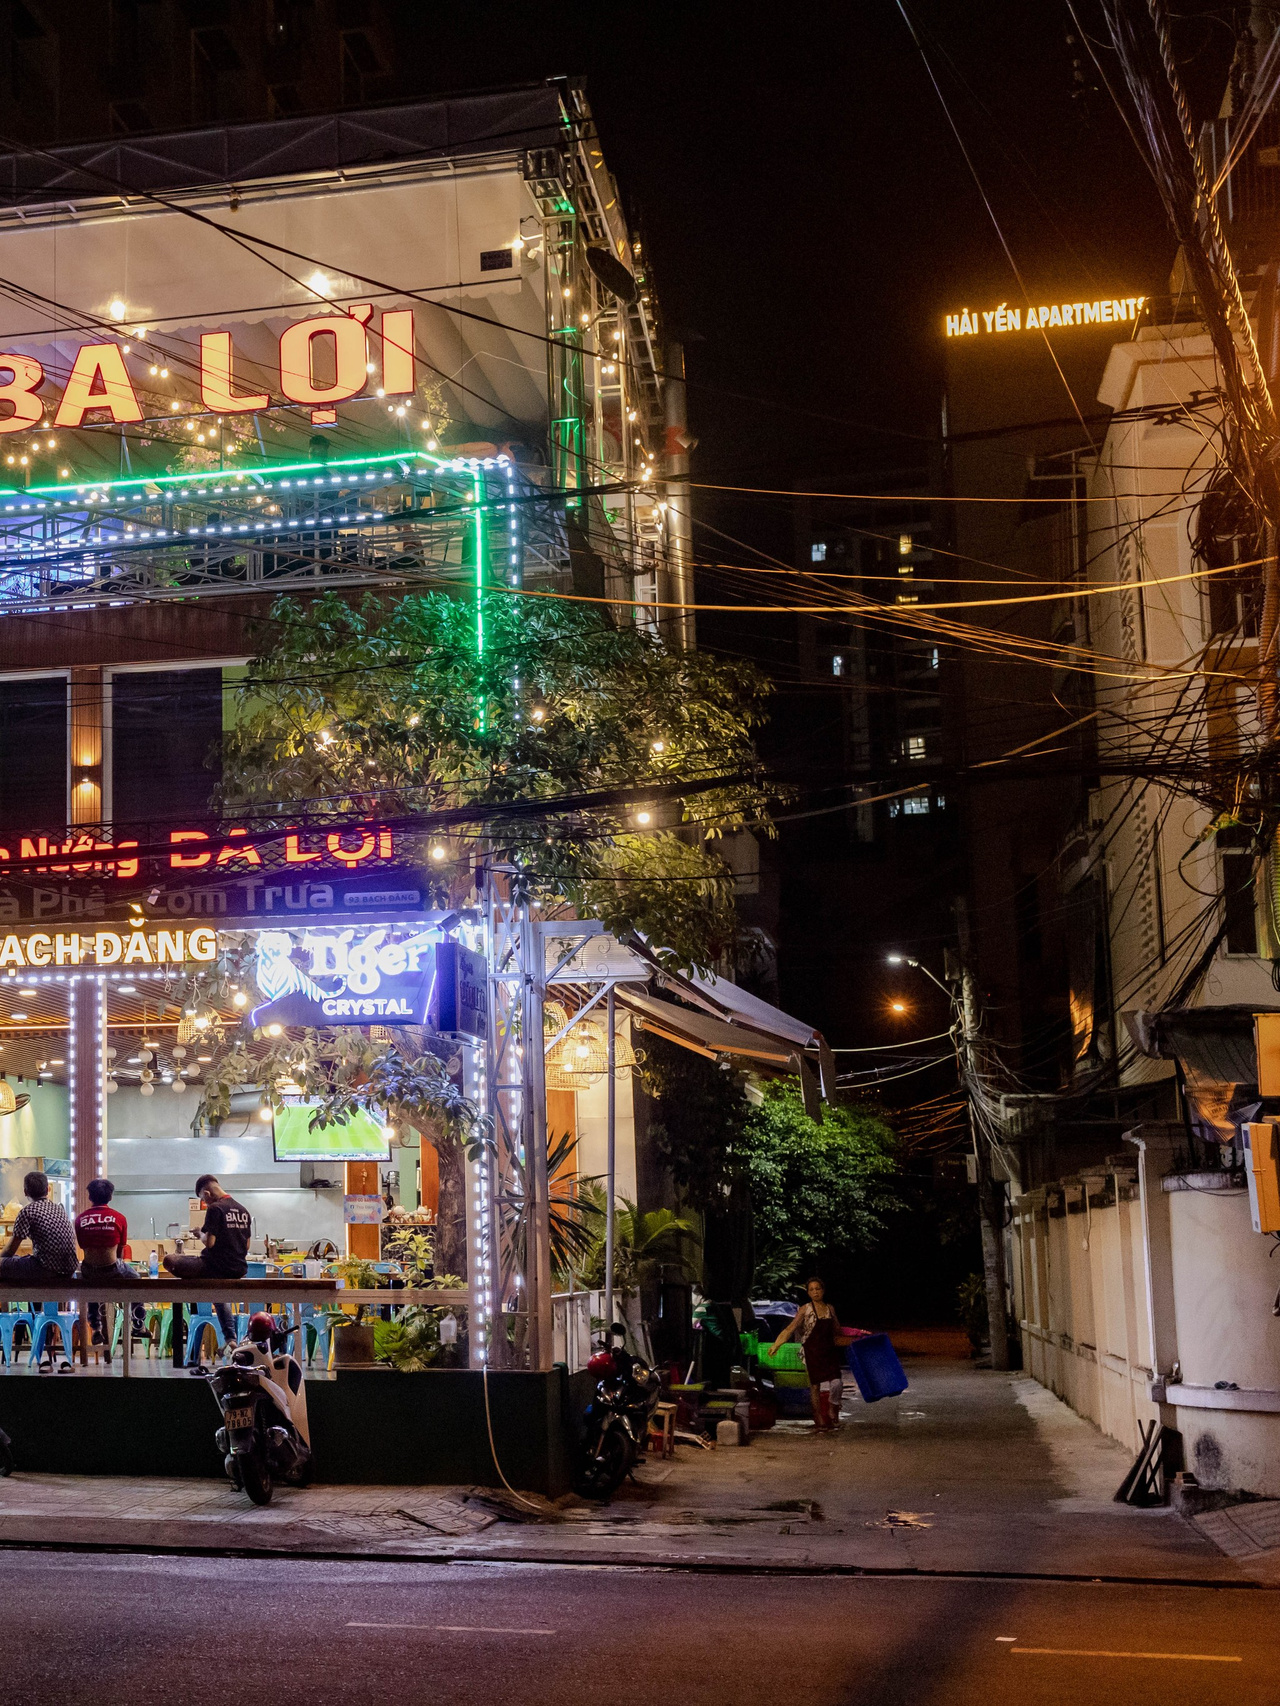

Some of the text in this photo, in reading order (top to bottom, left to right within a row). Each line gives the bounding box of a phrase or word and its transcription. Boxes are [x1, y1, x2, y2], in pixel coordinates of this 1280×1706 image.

[946, 308, 979, 337] HẢI
[982, 303, 1021, 333] YẾN
[200, 304, 415, 426] LỢI
[33, 884, 106, 918] Phê
[236, 878, 334, 911] Trưa
[348, 896, 360, 904] 93
[94, 902, 218, 966] ĐẰNG
[302, 929, 428, 995] Tiger
[322, 998, 413, 1016] CRYSTAL
